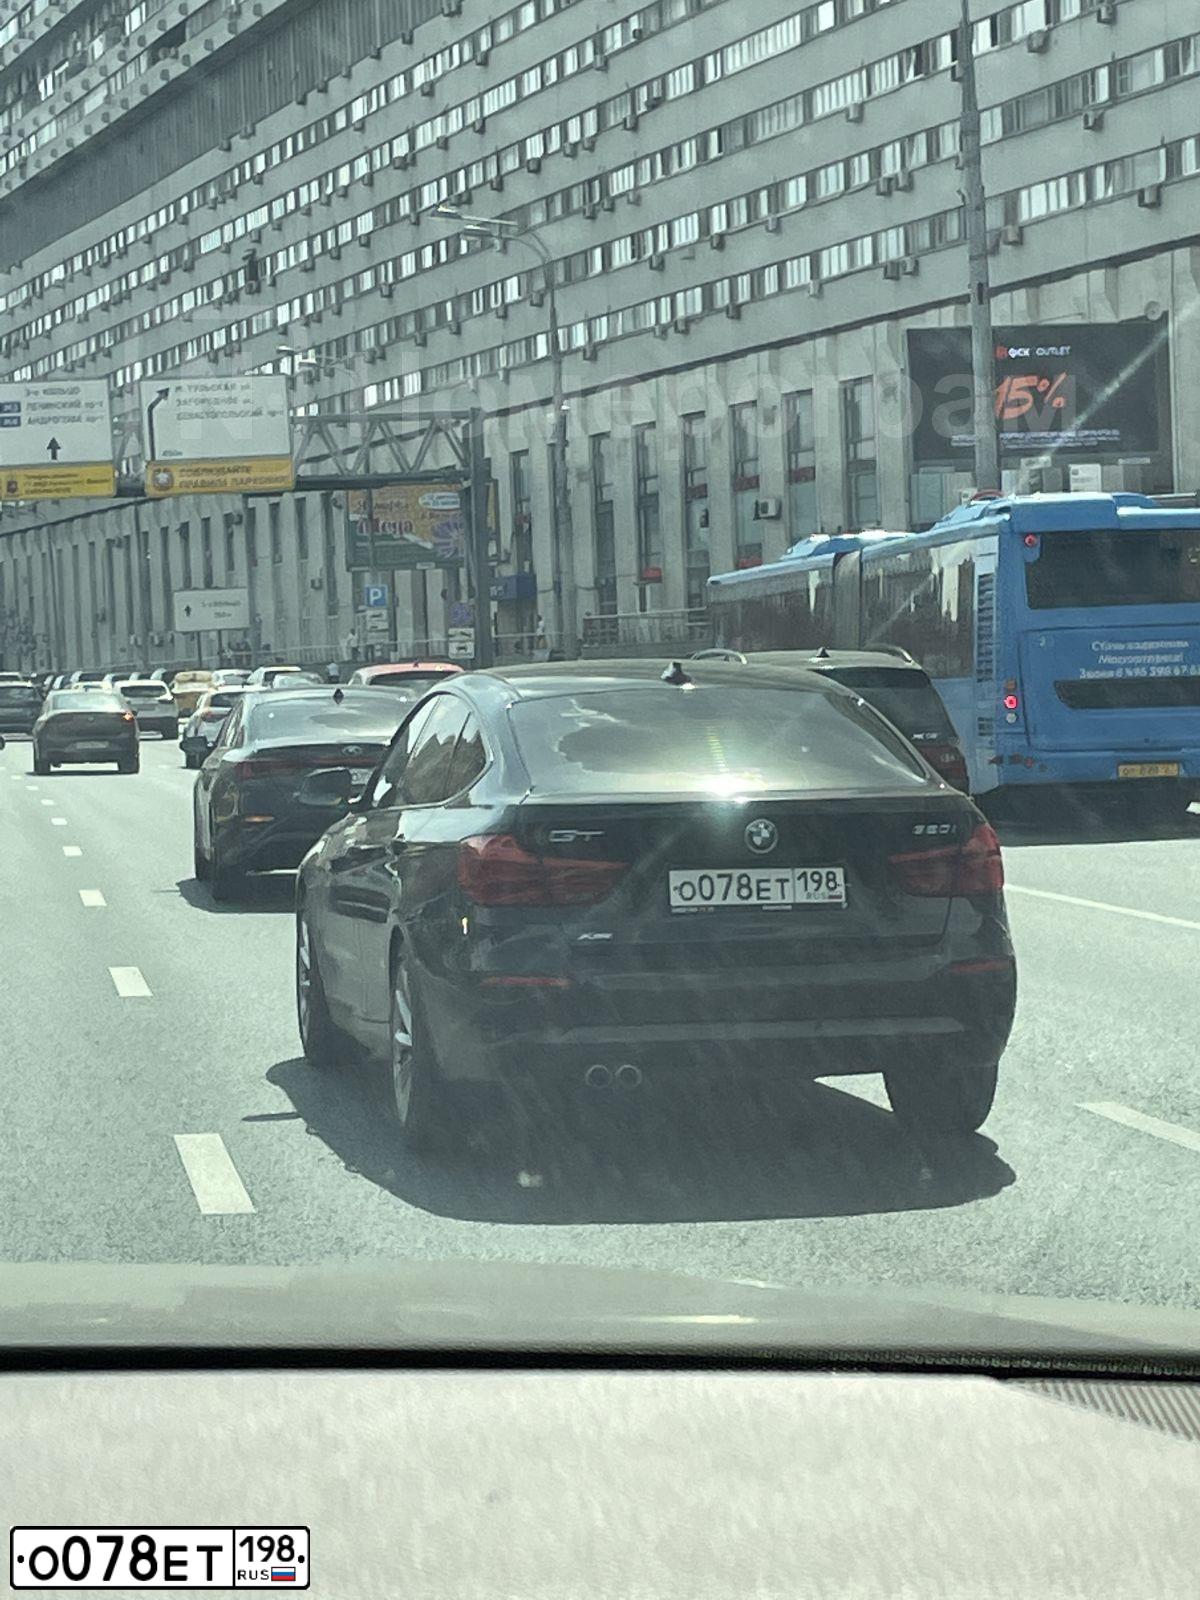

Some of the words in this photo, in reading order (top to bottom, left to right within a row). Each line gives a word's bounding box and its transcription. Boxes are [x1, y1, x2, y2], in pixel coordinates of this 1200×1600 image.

[1036, 345, 1071, 356] OUTLET
[993, 371, 1068, 420] 15%
[678, 873, 790, 902] О078ЕТ
[797, 870, 838, 893] 198
